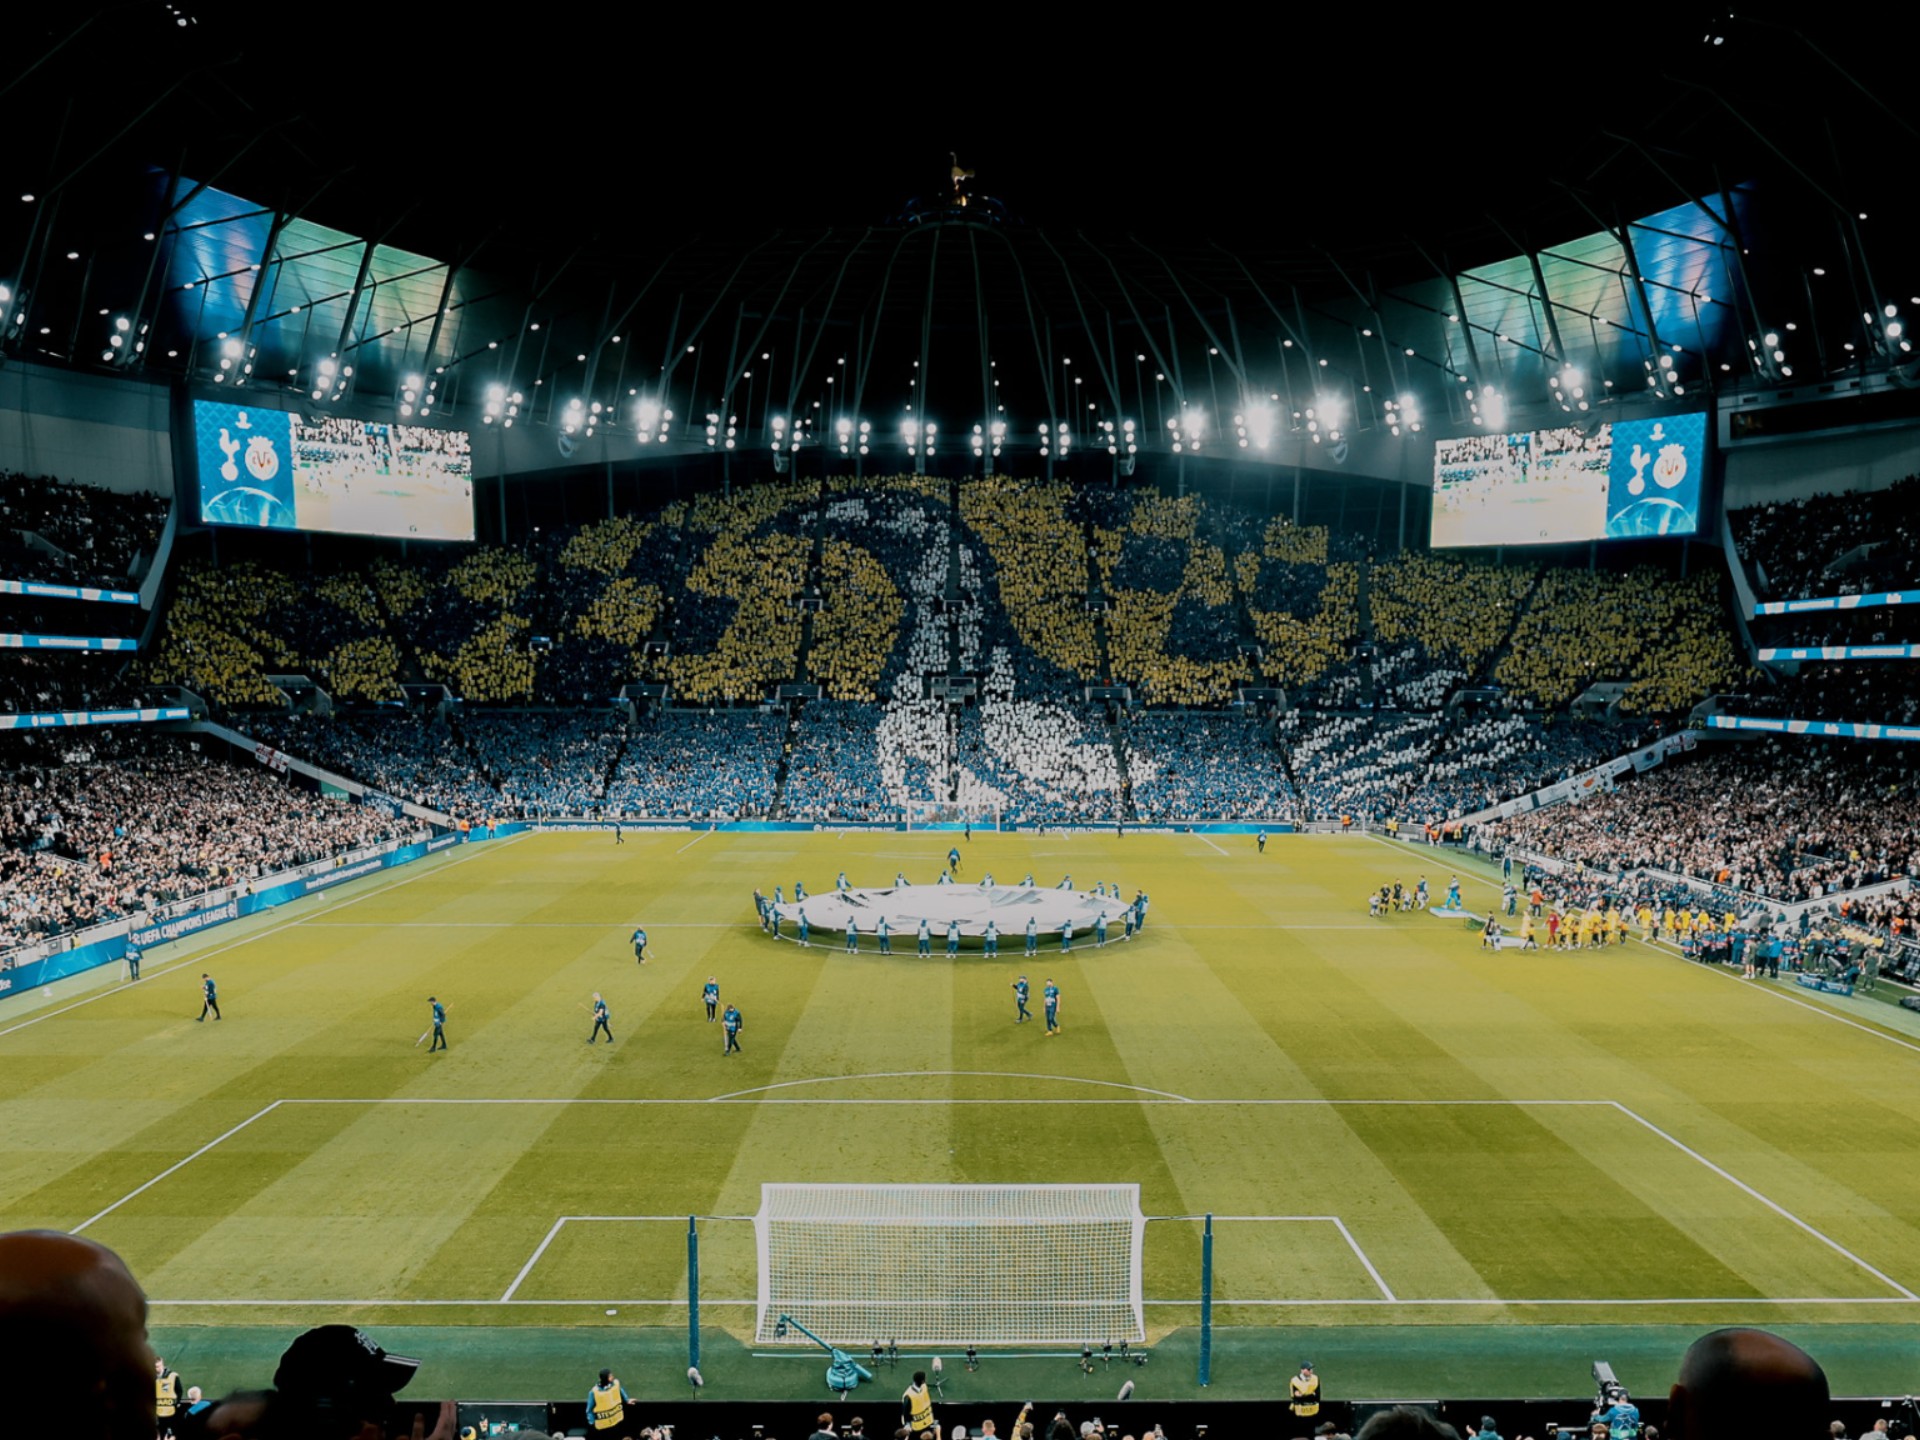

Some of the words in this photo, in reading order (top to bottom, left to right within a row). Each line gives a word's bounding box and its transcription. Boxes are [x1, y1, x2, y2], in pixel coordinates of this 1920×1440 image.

[141, 928, 161, 945] UEFA
[161, 913, 202, 939] CHAMPIONS
[202, 907, 228, 926] LEAGUE
